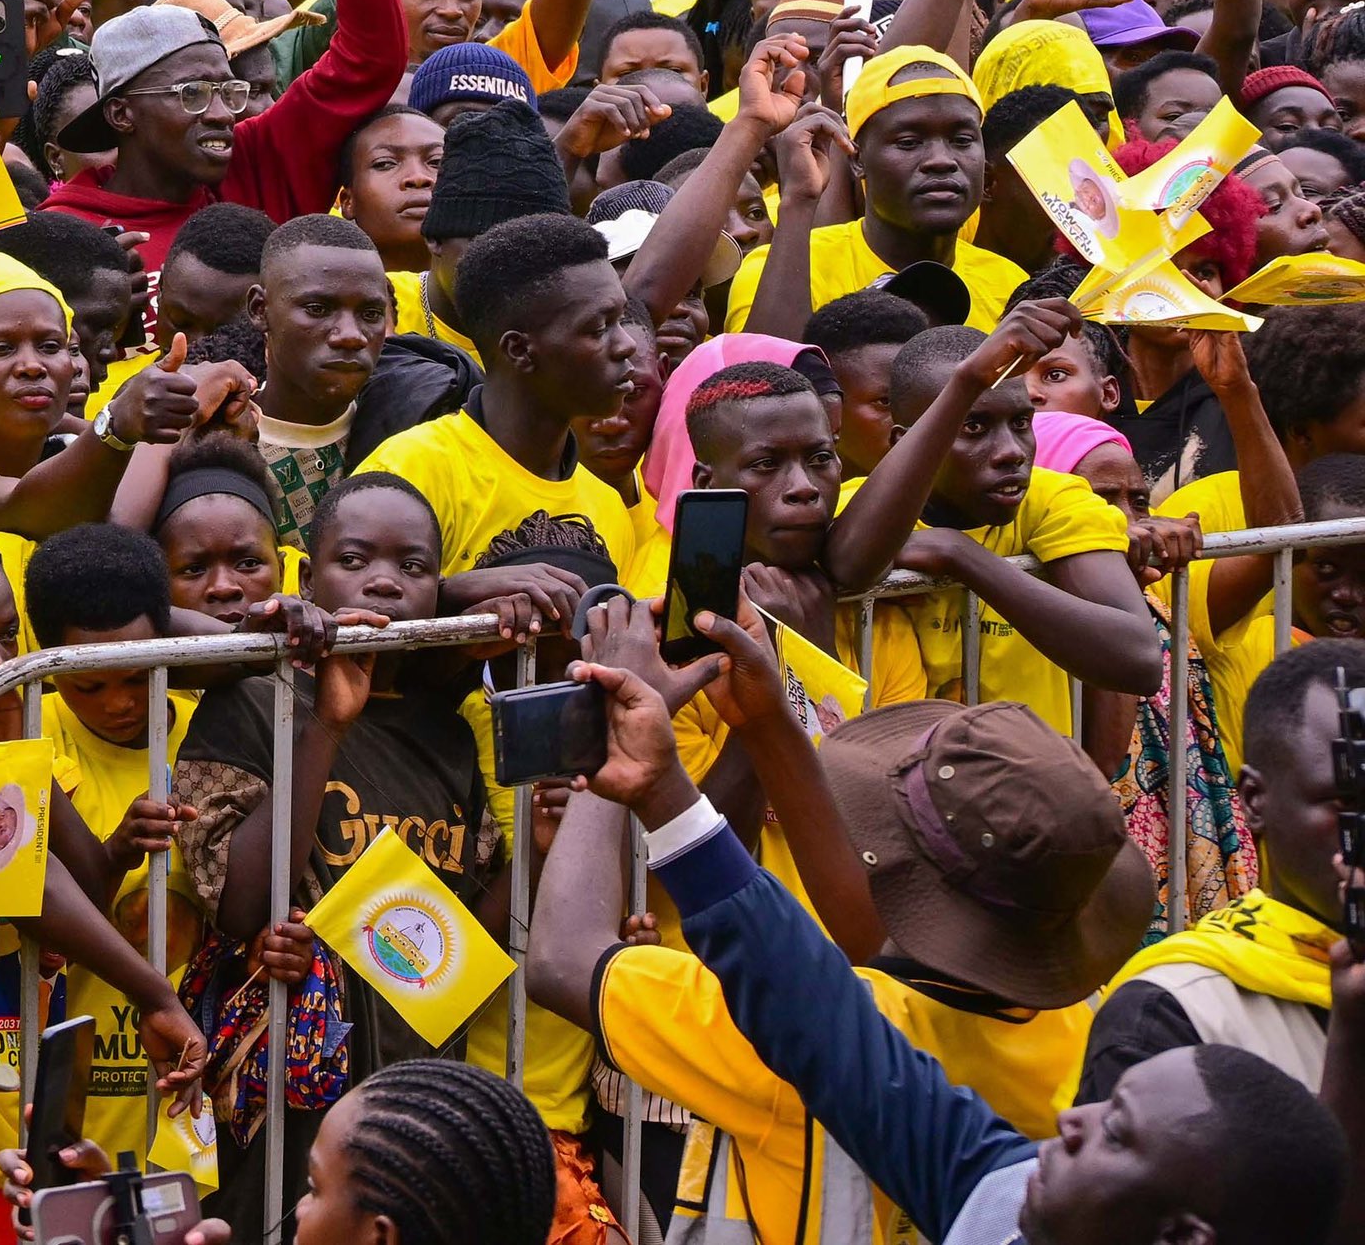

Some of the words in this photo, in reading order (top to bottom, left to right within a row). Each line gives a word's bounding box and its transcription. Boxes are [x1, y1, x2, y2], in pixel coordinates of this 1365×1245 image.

[449, 74, 528, 103] ESSENTIALS
[1041, 191, 1093, 257] MUSEVENI
[1054, 194, 1092, 246] YOWERI
[300, 453, 317, 465] LOUIS
[292, 495, 309, 507] LOUIS
[35, 807, 46, 851] PRESIDENT
[93, 1070, 149, 1083] PROTECT
